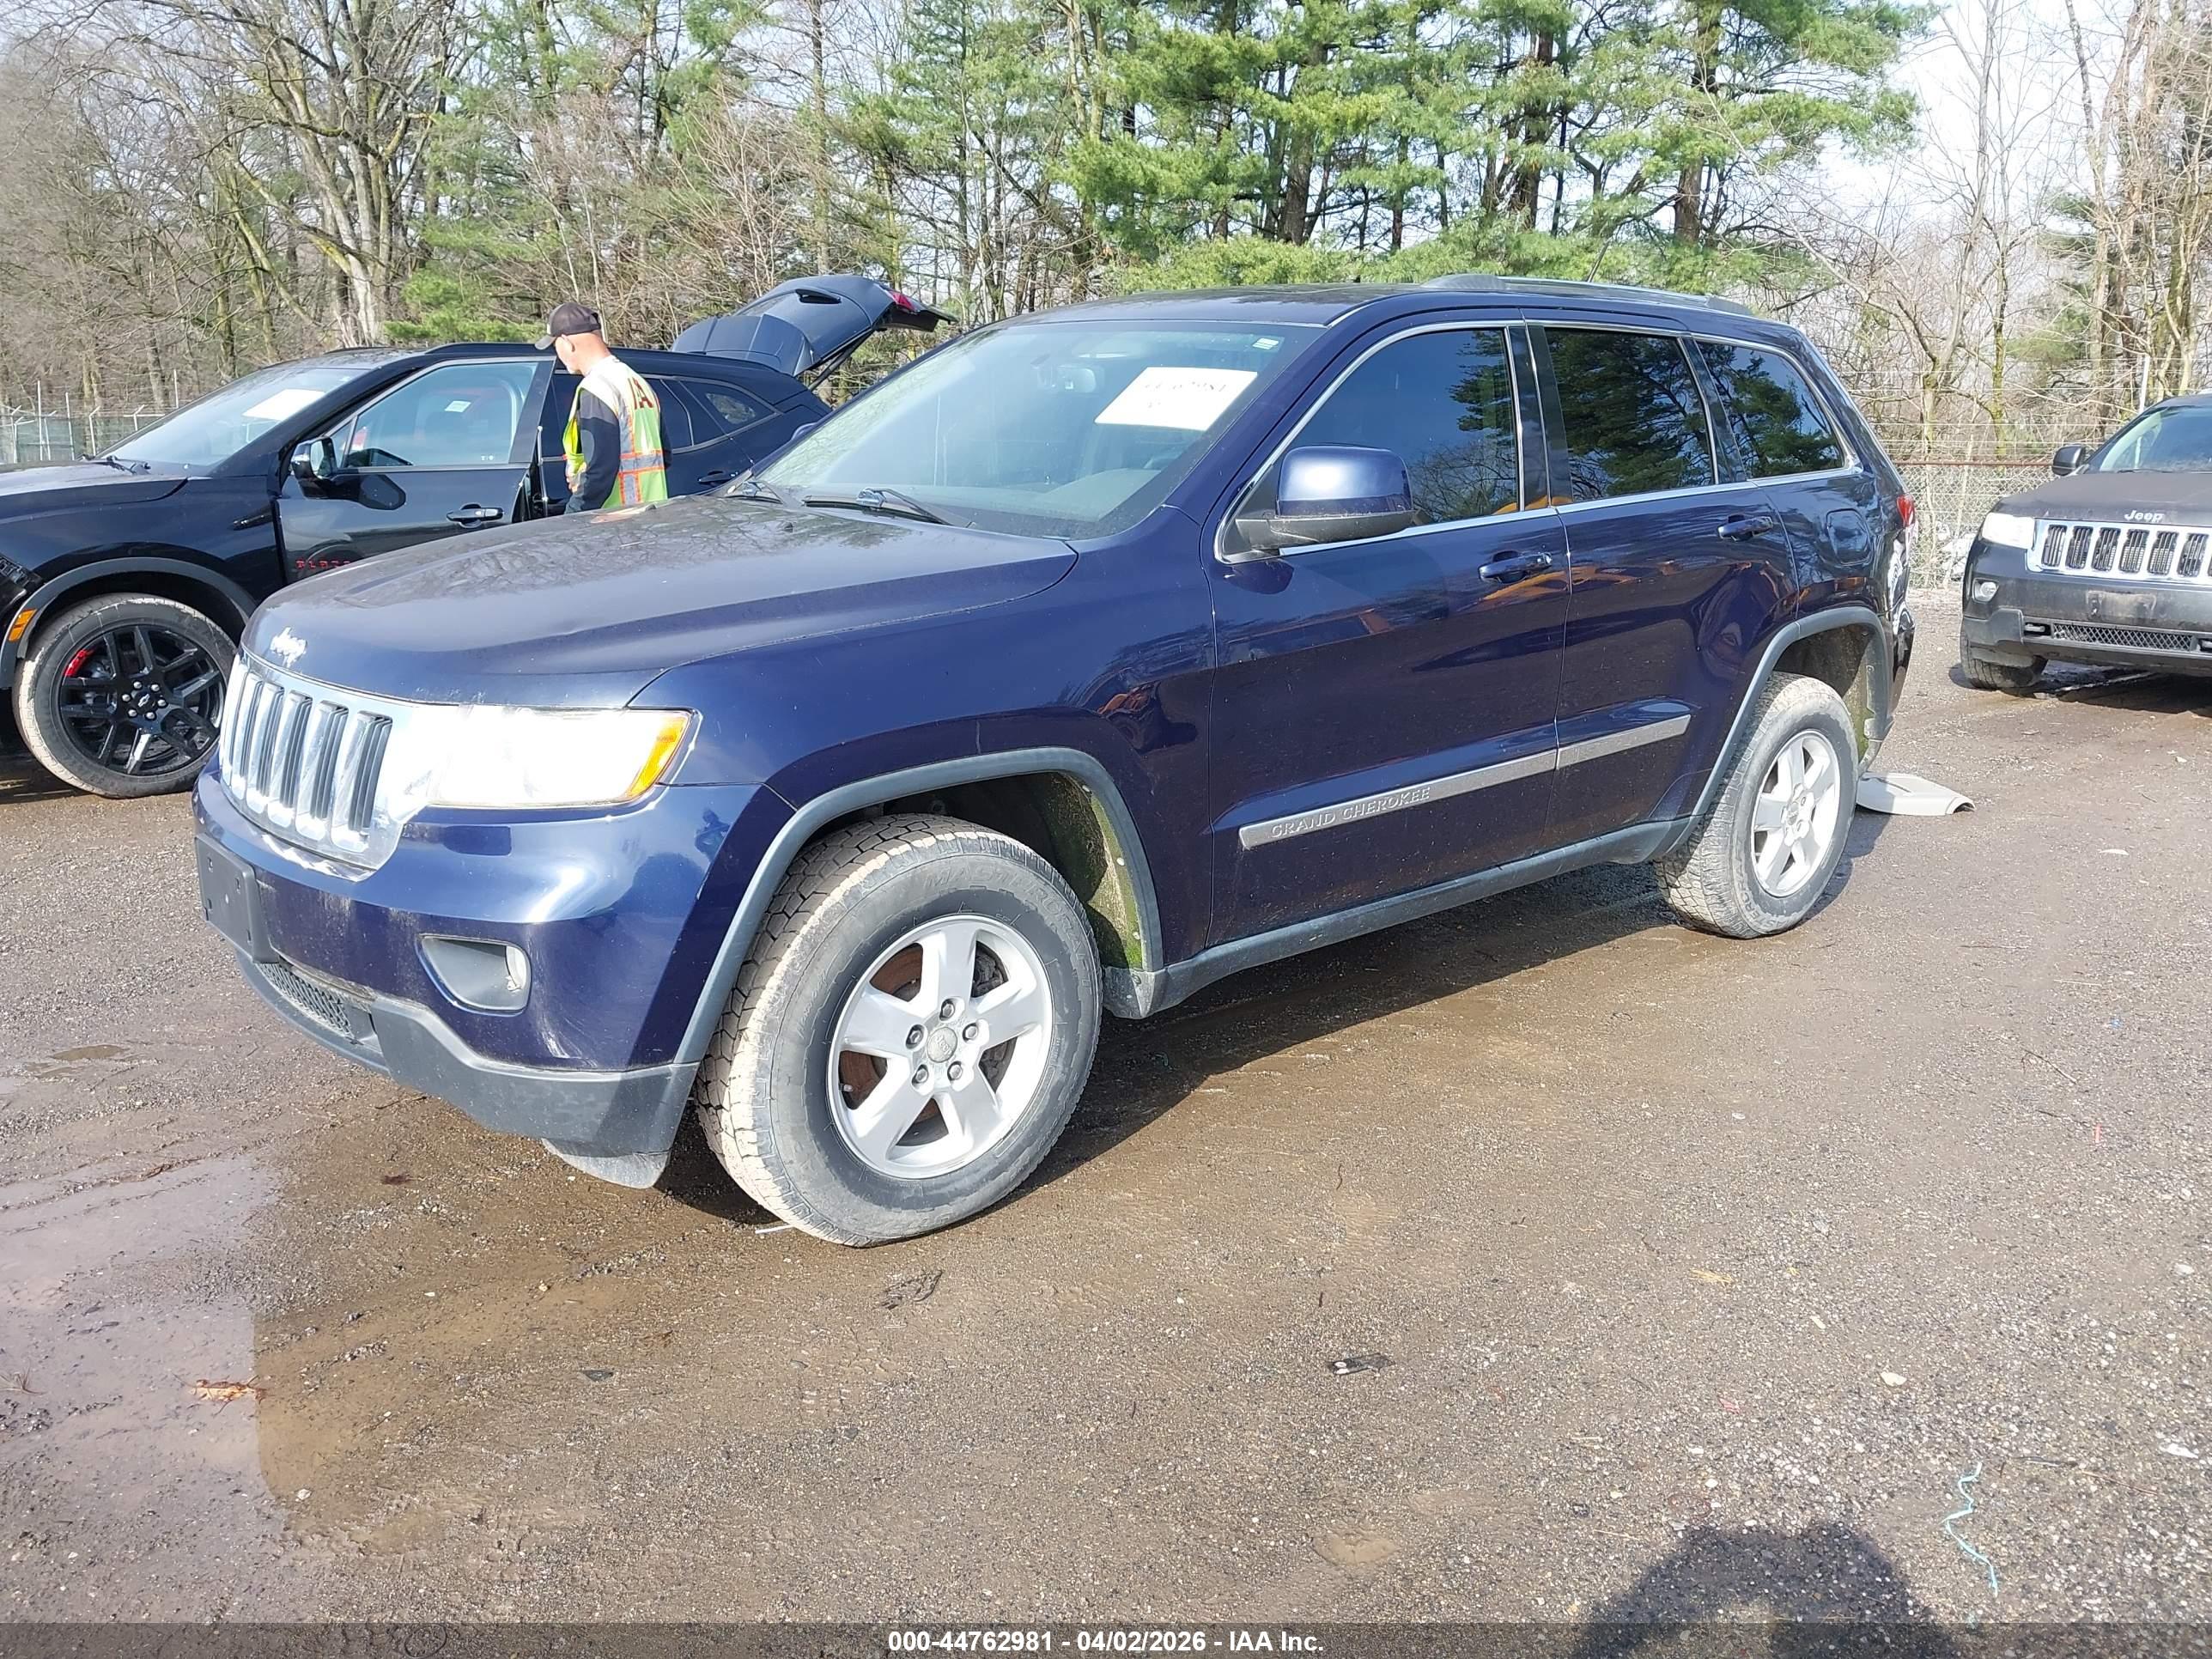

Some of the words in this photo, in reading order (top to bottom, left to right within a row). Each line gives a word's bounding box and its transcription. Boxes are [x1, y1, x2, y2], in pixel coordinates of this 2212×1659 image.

[2124, 509, 2166, 524] Jeep
[1270, 812, 1337, 839] GRAND
[1340, 786, 1431, 821] CHEROKEE
